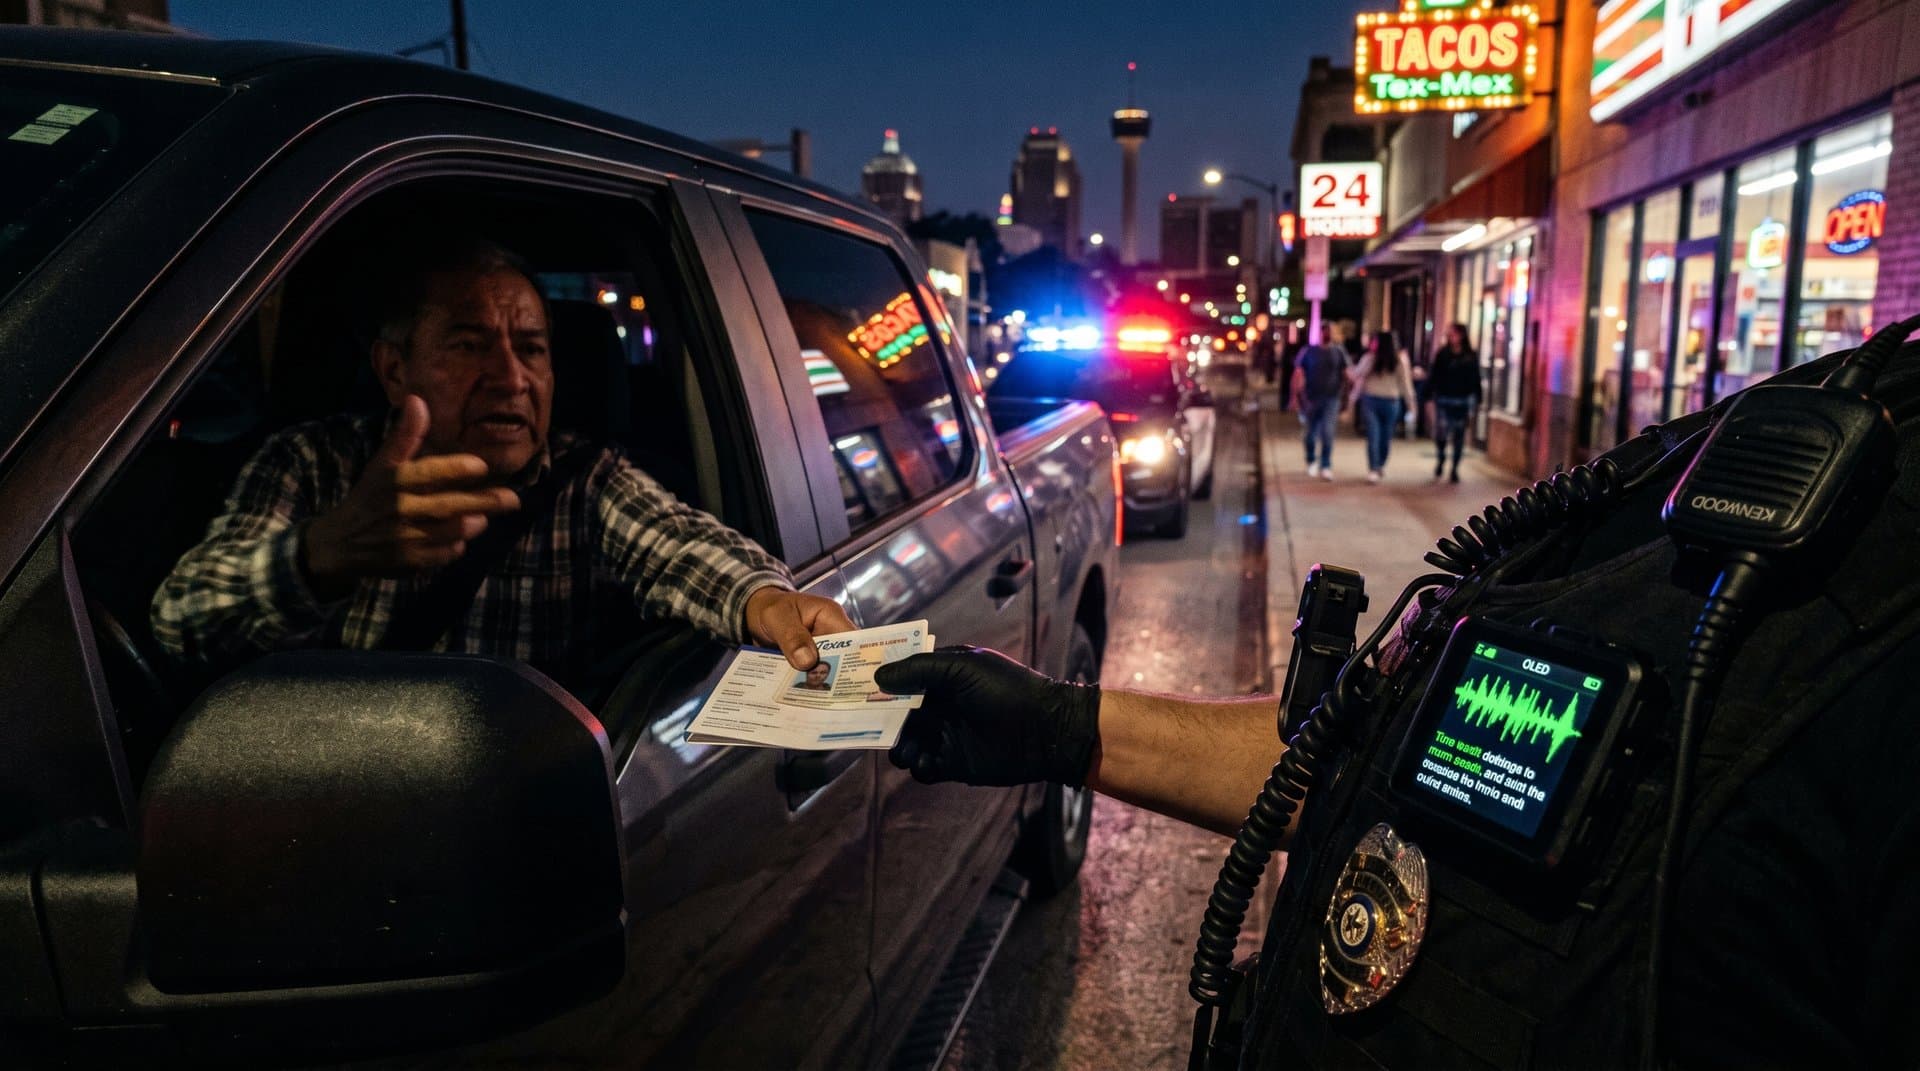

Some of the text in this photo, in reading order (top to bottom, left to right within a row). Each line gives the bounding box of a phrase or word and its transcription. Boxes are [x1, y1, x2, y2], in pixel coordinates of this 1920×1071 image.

[1374, 21, 1519, 72] TACOS
[1369, 70, 1514, 99] Tex-Mex
[1312, 173, 1371, 208] 24
[1824, 200, 1888, 244] OPEN
[1691, 495, 1777, 522] KENWOOD
[816, 639, 853, 650] Texas
[1522, 658, 1551, 676] OLED
[1483, 768, 1505, 784] and
